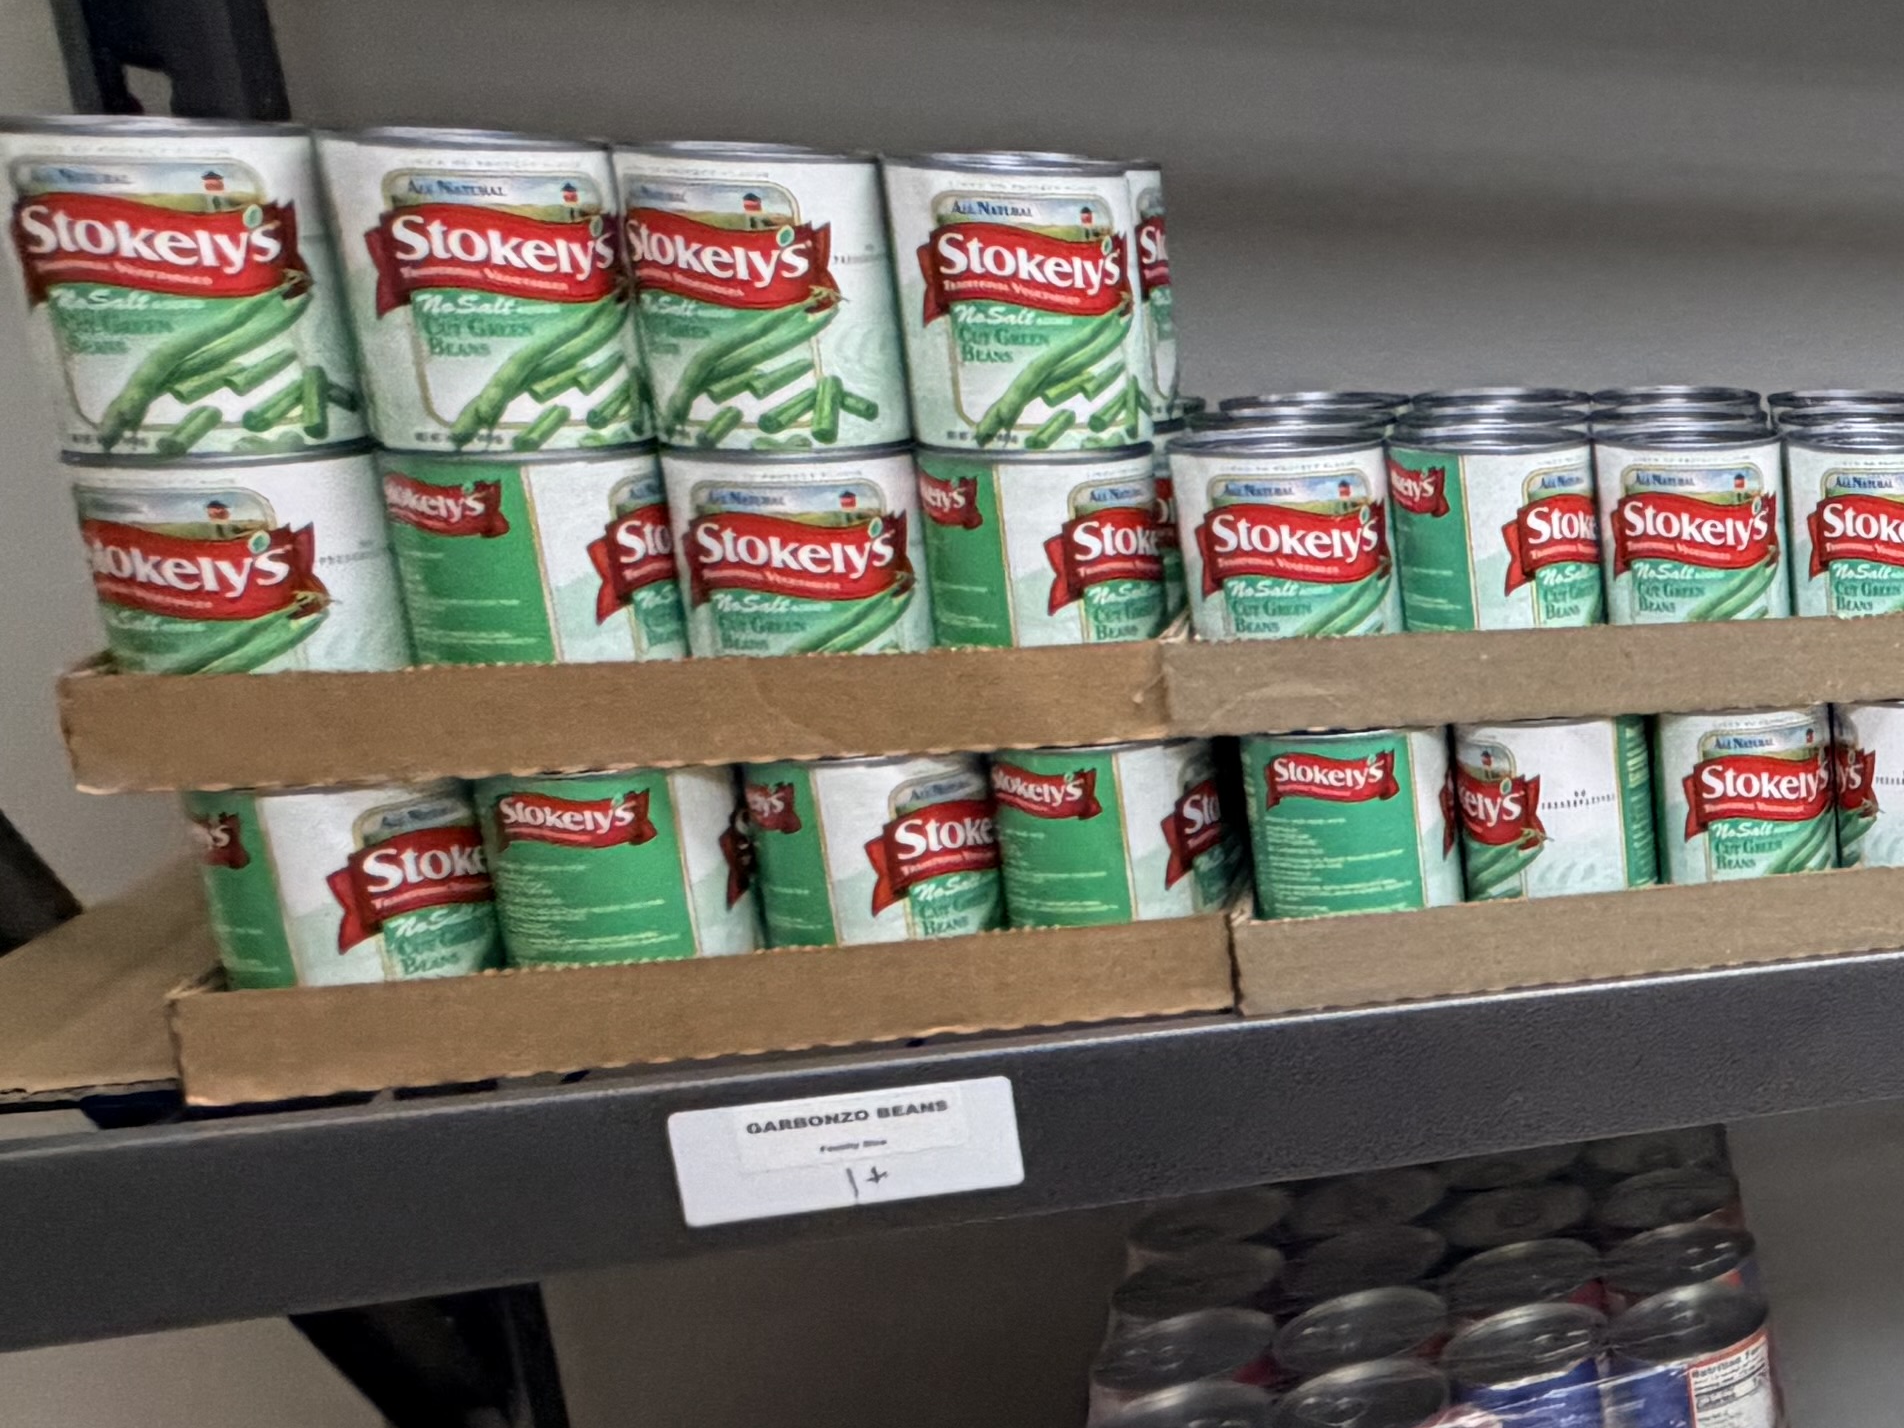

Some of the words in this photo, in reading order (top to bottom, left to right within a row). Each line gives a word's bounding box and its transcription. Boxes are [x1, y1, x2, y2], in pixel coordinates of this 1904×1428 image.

[20, 203, 282, 276] Stokely's
[391, 214, 615, 282] Stokely's
[626, 218, 813, 288] Stokely's
[936, 231, 1121, 296] Stokely's
[989, 306, 1036, 325] Salt
[1211, 513, 1379, 563] Stokely's
[1623, 500, 1769, 551] Stokely's
[697, 522, 896, 580] Stokely's
[1271, 757, 1385, 791] Stokely's
[1700, 764, 1828, 802] Stokely's
[500, 796, 635, 835] Stokely's
[745, 1109, 870, 1135] GARBONZO
[876, 1099, 949, 1119] BEANS
